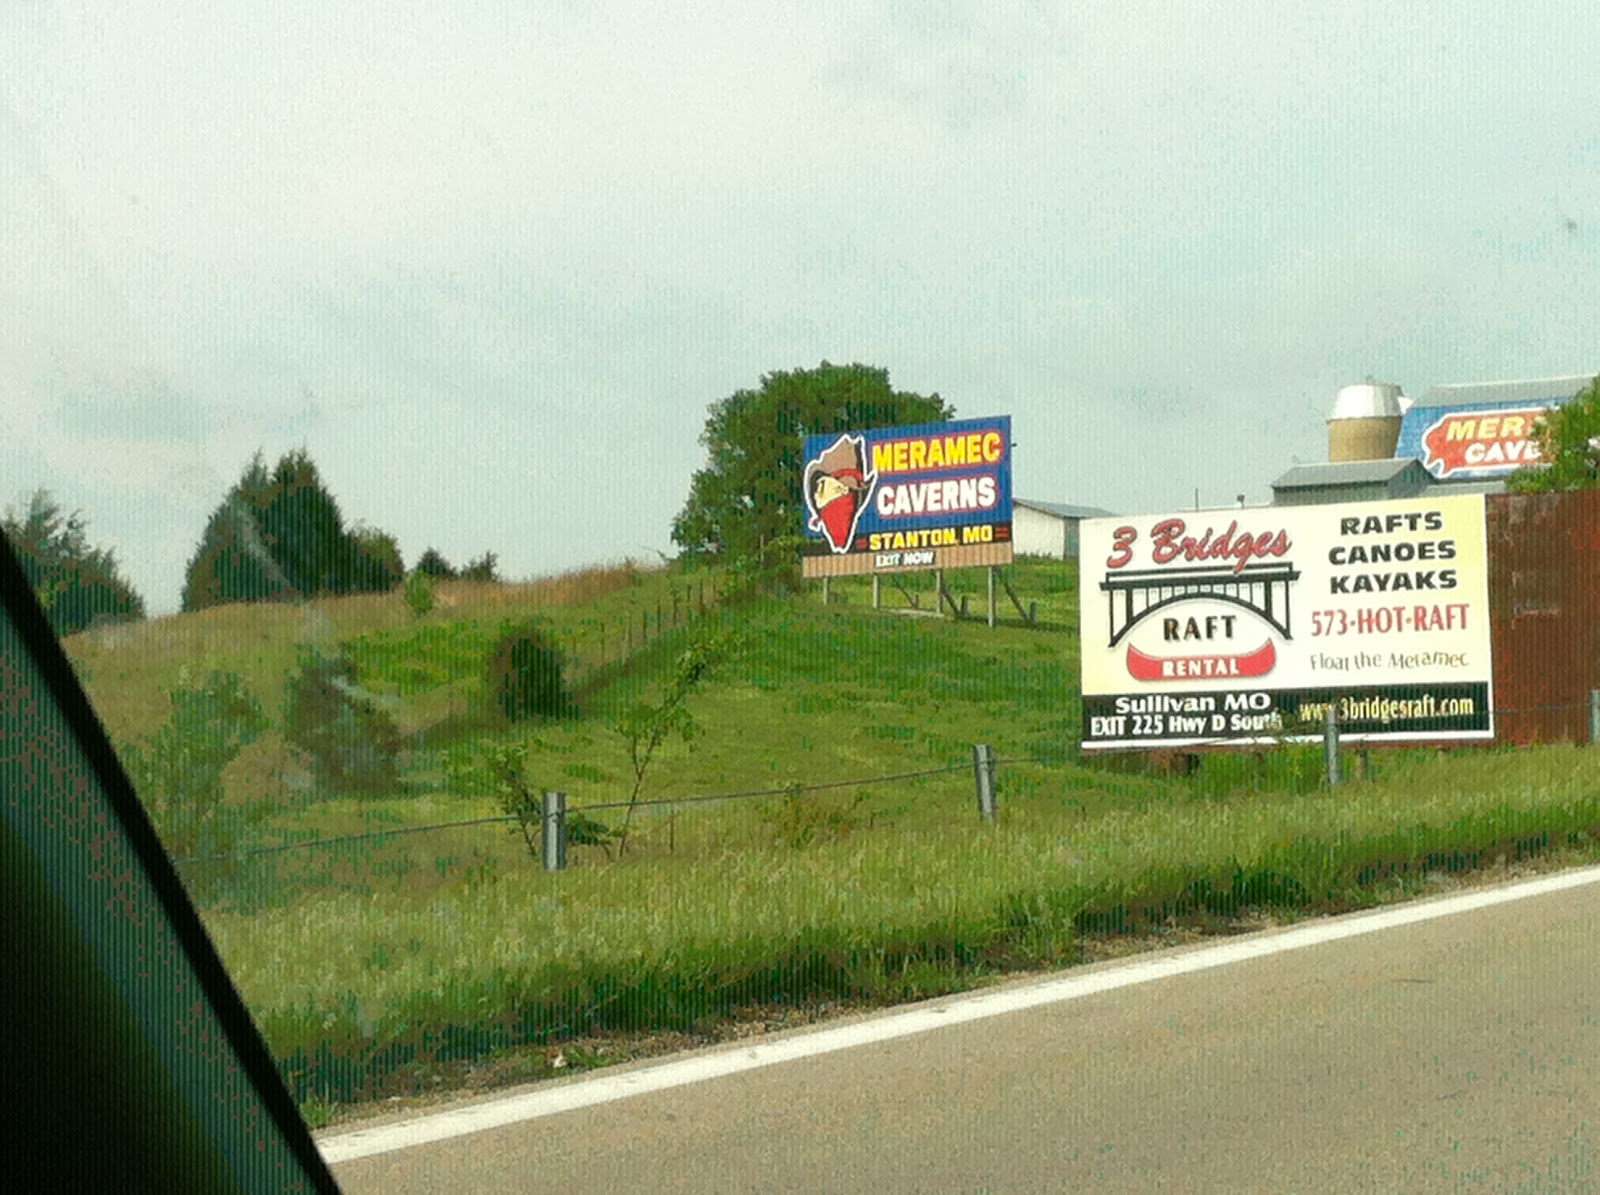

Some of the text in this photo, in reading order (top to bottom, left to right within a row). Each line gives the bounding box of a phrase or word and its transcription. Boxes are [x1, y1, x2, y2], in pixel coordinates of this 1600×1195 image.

[872, 432, 1001, 472] MERAMEC
[877, 476, 996, 516] CAVERNS
[962, 525, 993, 544] MO
[1340, 511, 1443, 536] RAFTS
[1107, 518, 1292, 574] 3 Bridges
[1328, 540, 1457, 566] CANOES
[875, 551, 934, 567] EXIT NOW
[1330, 569, 1458, 594] KAYAKS
[1163, 615, 1236, 641] RAFT
[1162, 658, 1240, 677] RENTAL
[1310, 651, 1469, 671] Float the Meramec
[1115, 692, 1272, 714] Sullivan MO
[1090, 716, 1127, 736] EXIT
[1132, 715, 1164, 735] 225
[1168, 715, 1207, 735] Hwy
[1212, 714, 1226, 731] D
